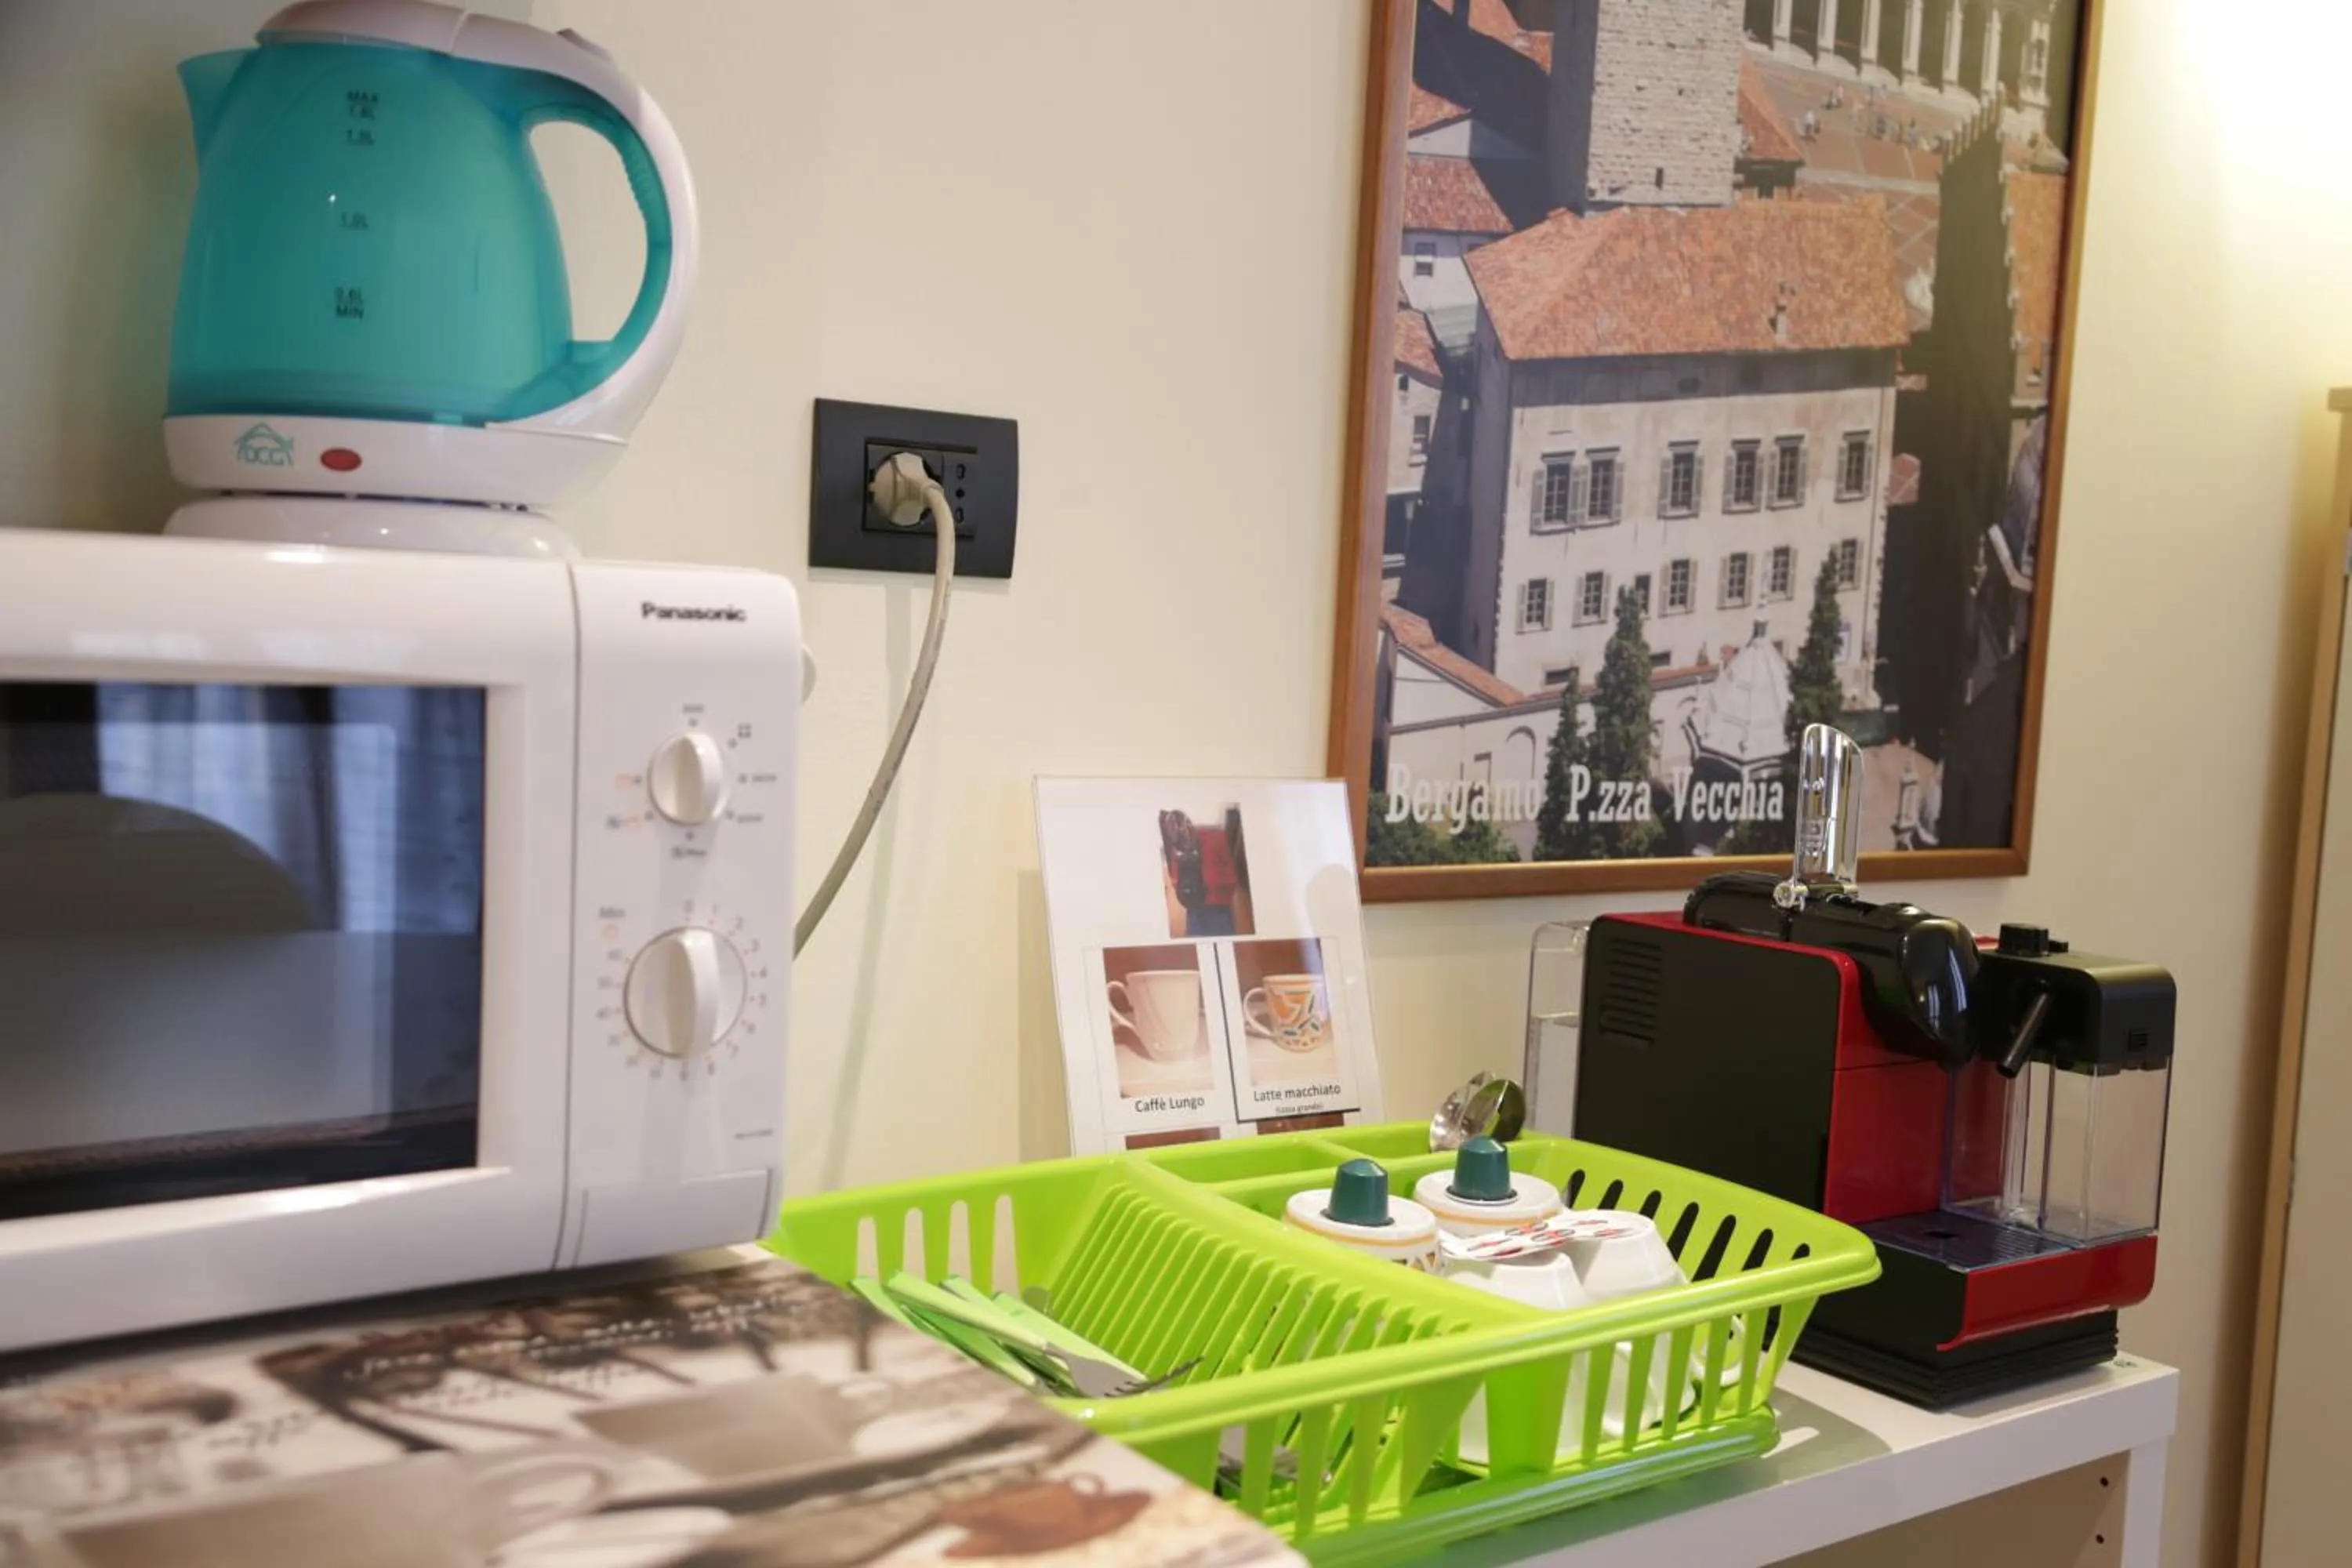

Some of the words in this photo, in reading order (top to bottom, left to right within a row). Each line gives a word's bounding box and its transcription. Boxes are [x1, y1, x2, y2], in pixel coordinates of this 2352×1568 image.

[641, 601, 746, 622] Panasonic
[1385, 762, 1542, 834] Bergamo
[1566, 764, 1652, 822] P.zza
[1671, 765, 1785, 822] Vecchia
[1254, 1090, 1282, 1103] Latte
[1284, 1083, 1341, 1099] macchiato
[1134, 1098, 1166, 1113] Caffè
[1169, 1096, 1205, 1111] Lungo
